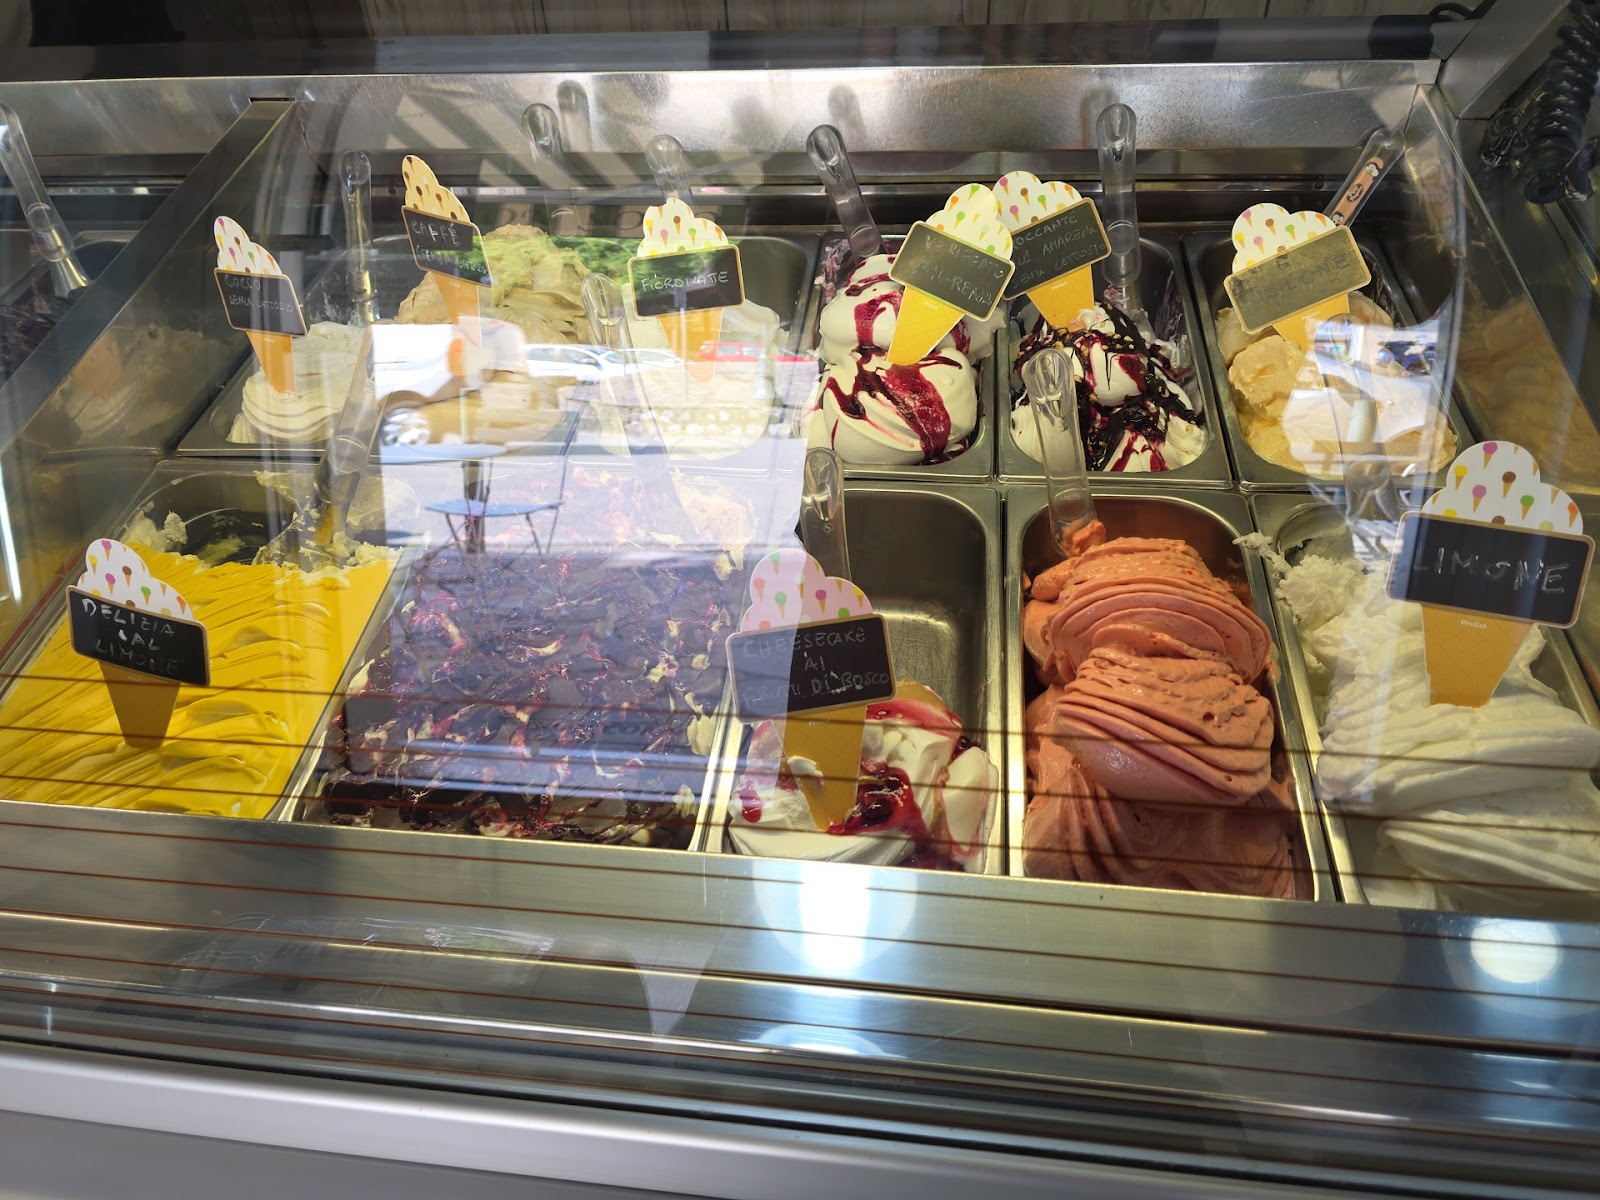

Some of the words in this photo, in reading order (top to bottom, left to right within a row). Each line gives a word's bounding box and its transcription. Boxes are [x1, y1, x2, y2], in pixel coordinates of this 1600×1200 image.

[1014, 211, 1078, 250] OCCANTE
[1414, 541, 1570, 593] LIMONE
[81, 598, 175, 636] DELIZIA
[743, 627, 866, 658] CHEESECAKE
